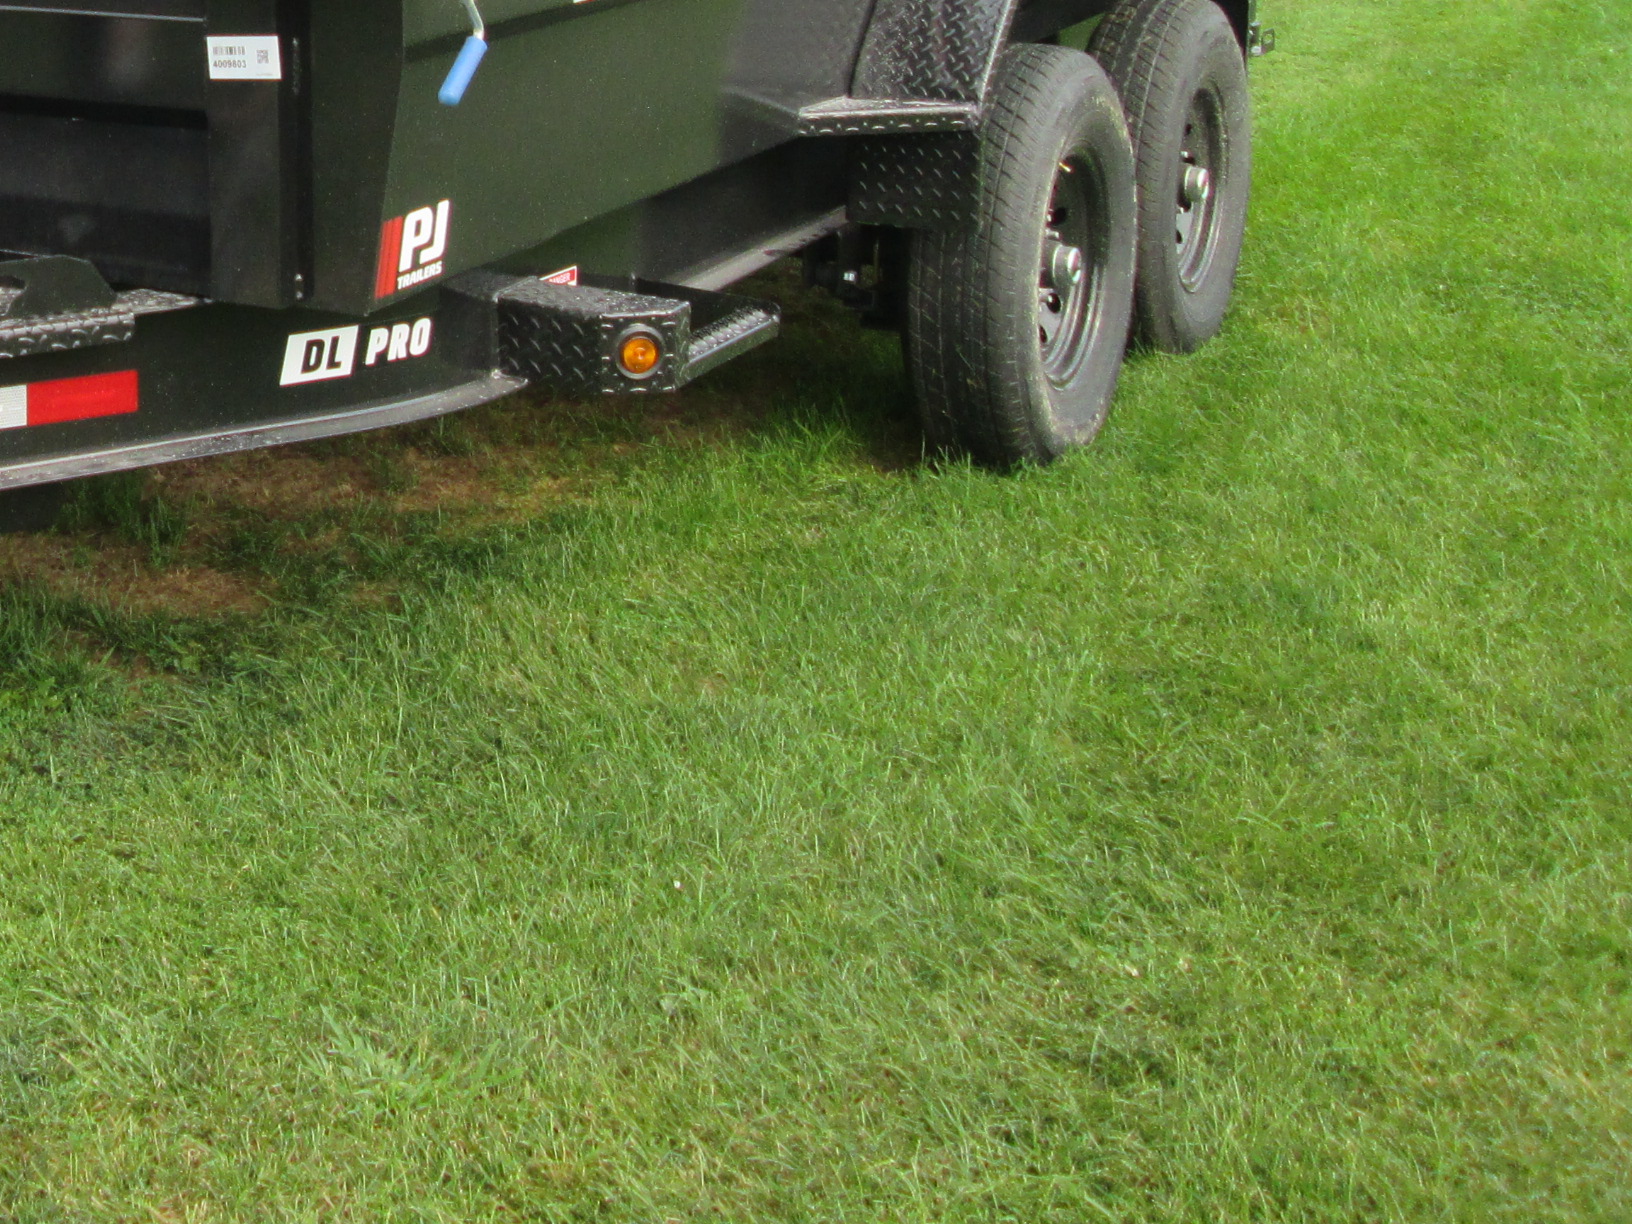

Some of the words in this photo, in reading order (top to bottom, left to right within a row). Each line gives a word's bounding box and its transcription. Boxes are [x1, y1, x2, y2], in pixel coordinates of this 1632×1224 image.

[212, 59, 247, 68] 4009803
[399, 199, 450, 273] PJ
[397, 261, 443, 290] TRAILERS
[300, 334, 343, 375] DL
[365, 317, 433, 366] PRO
